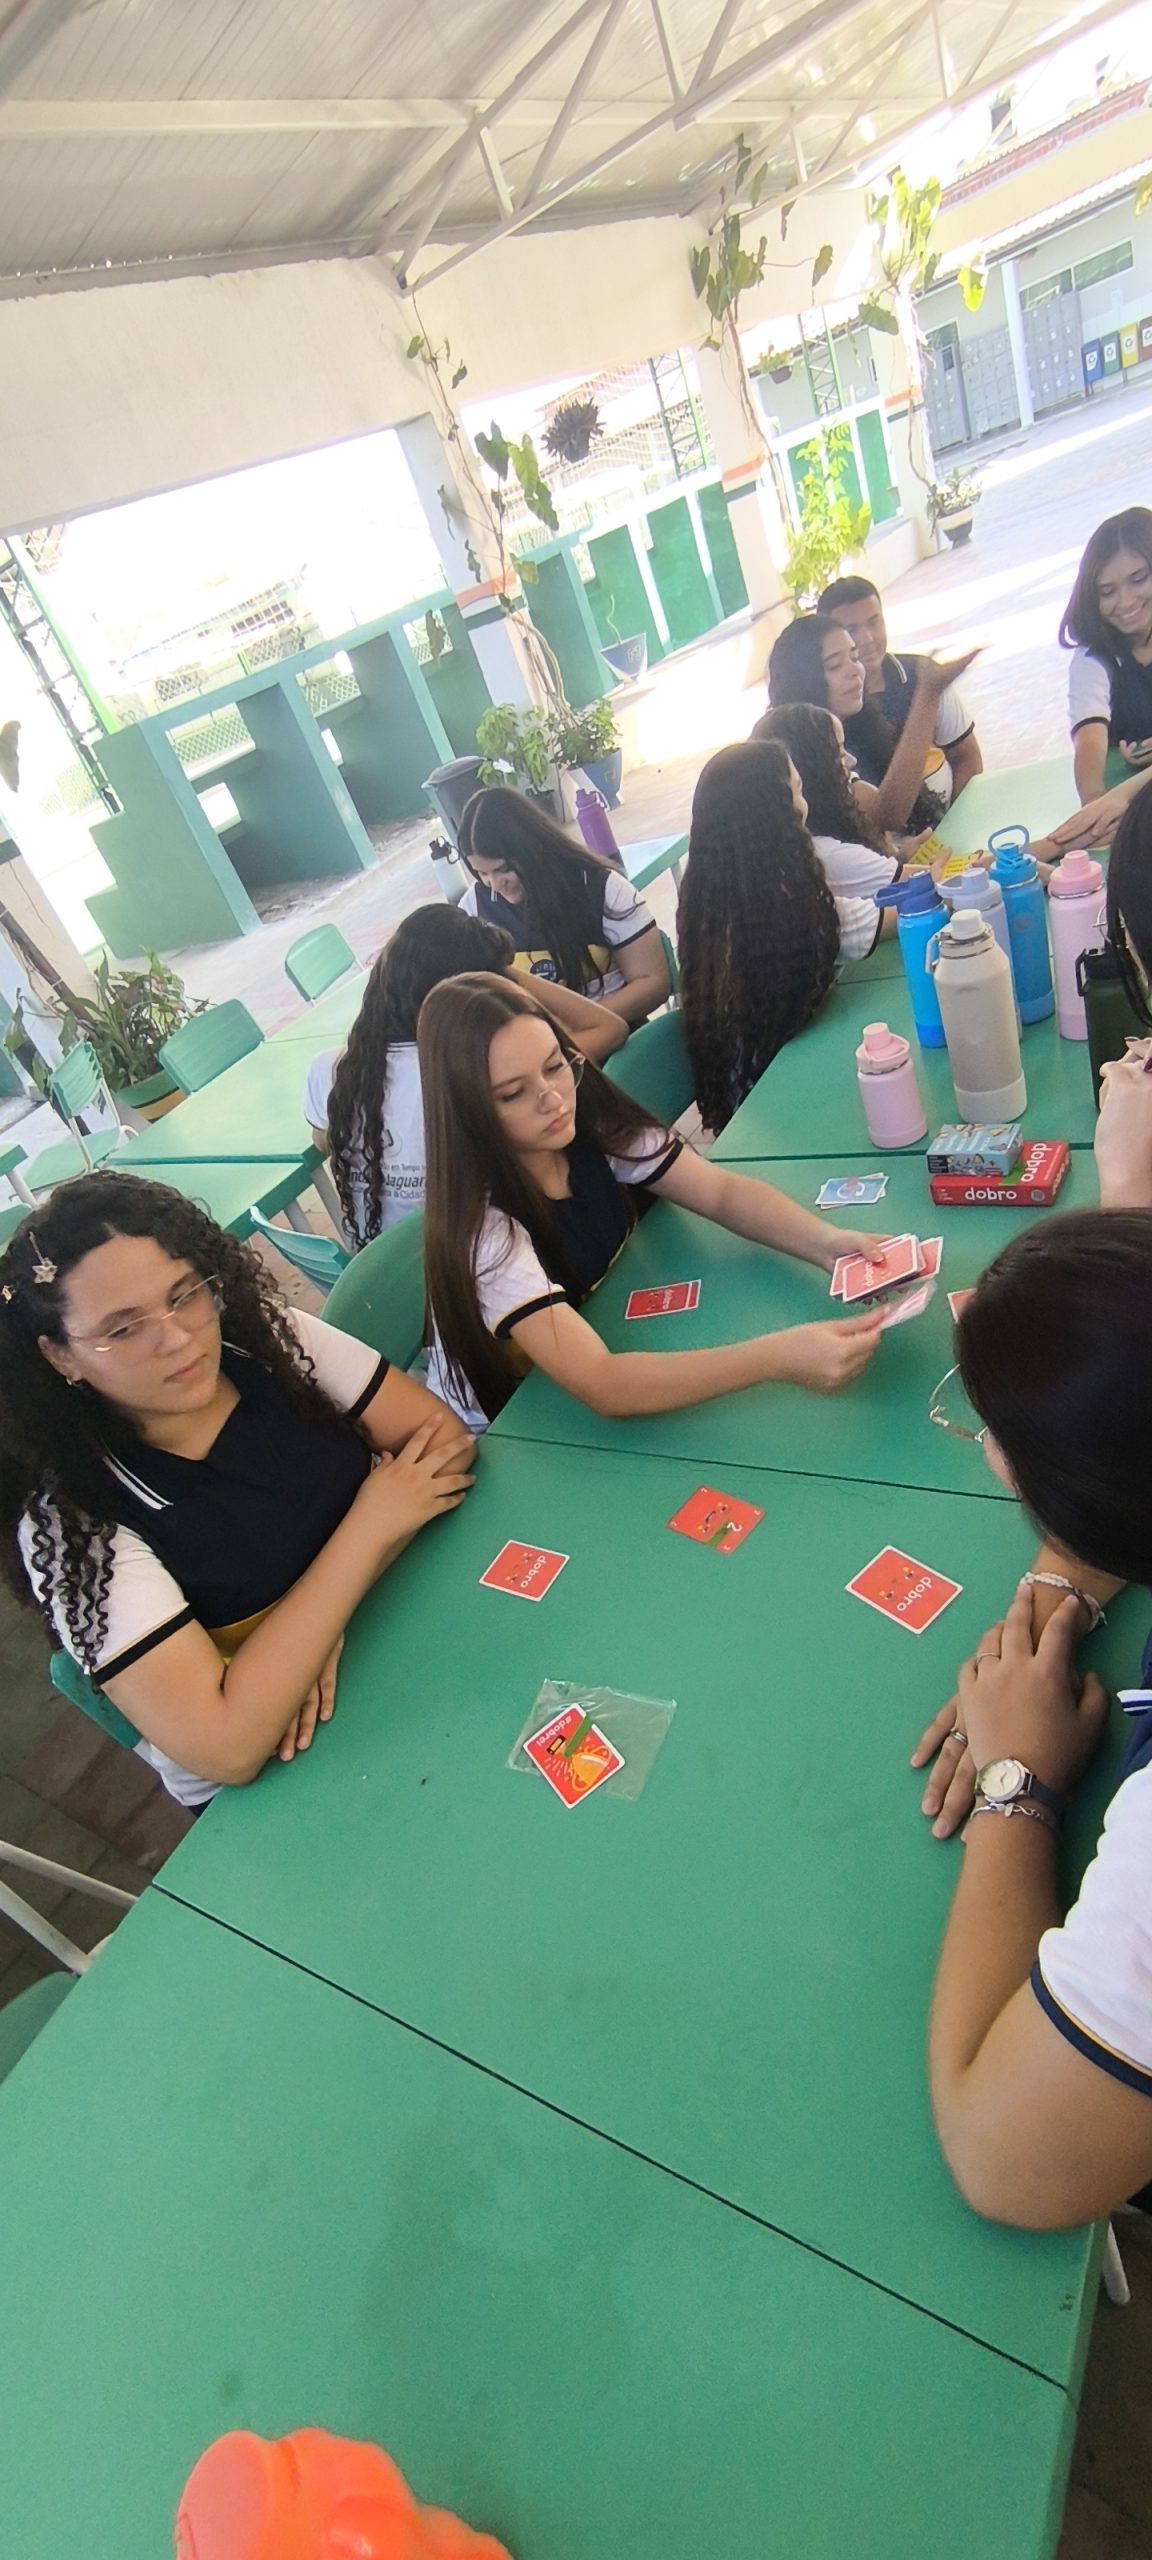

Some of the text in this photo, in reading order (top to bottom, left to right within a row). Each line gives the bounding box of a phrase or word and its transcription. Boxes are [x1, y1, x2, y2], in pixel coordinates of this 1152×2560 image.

[1021, 1143, 1052, 1182] dobro
[965, 1187, 1017, 1201] dobro
[727, 1521, 742, 1532] 2
[521, 1555, 546, 1588] dobro
[896, 1576, 933, 1612] dobro
